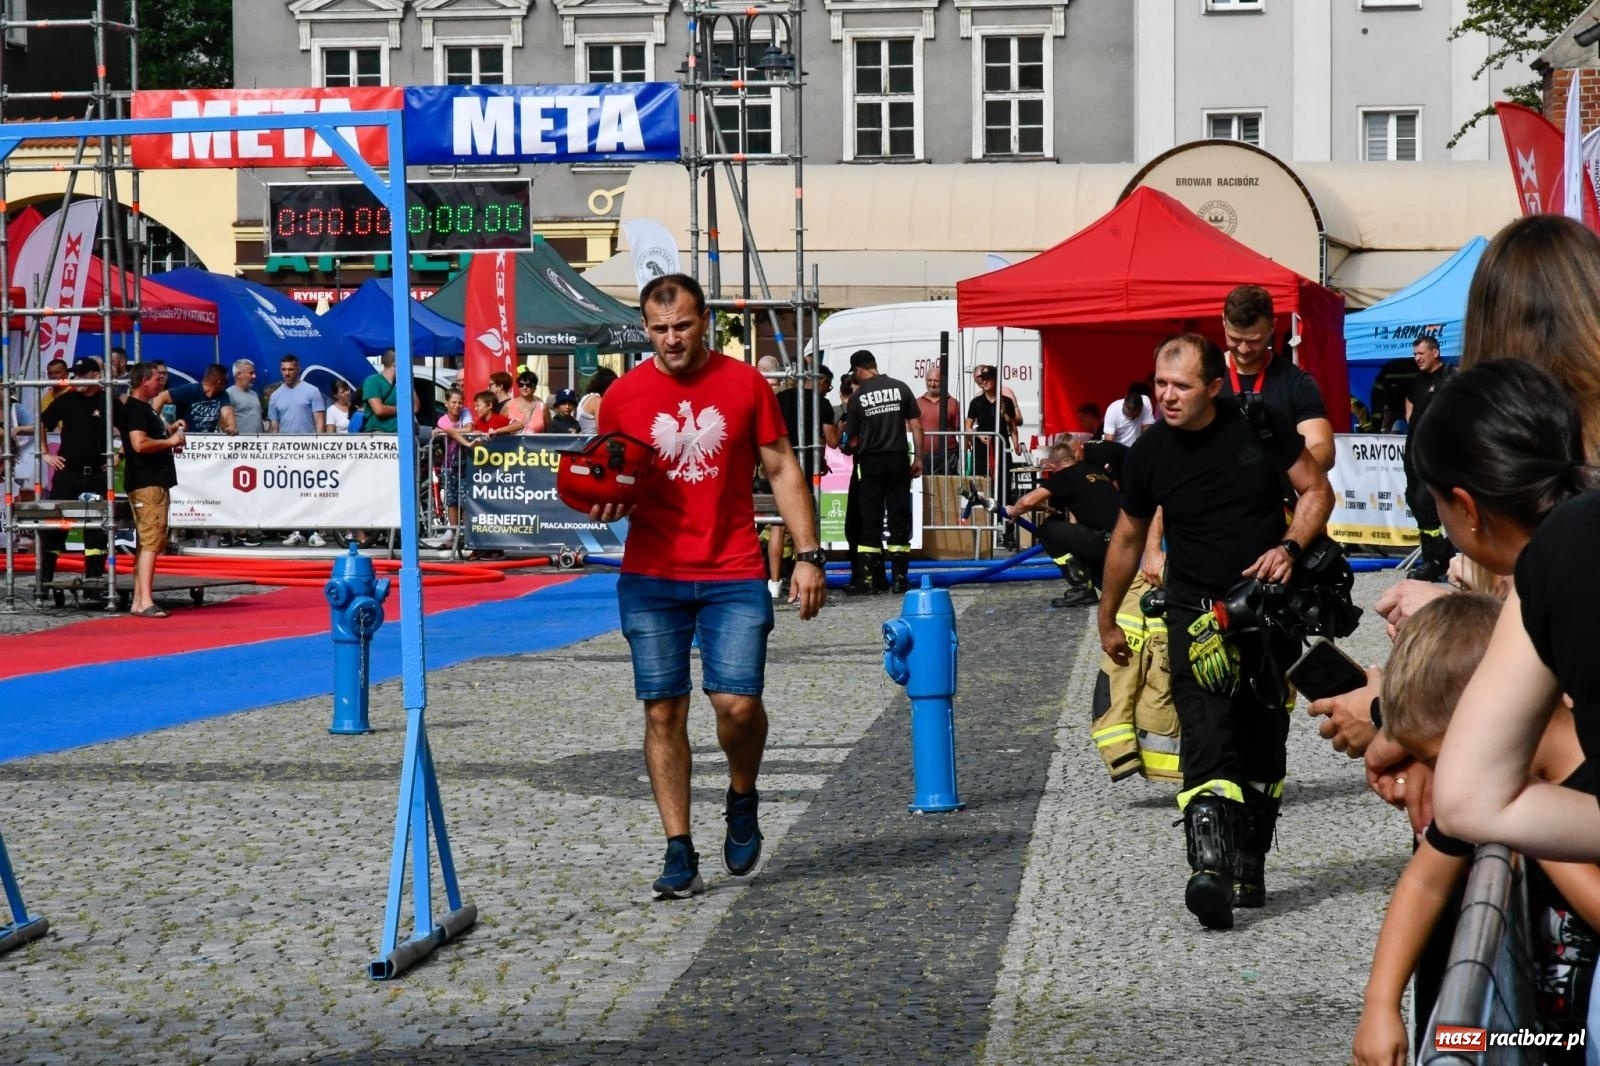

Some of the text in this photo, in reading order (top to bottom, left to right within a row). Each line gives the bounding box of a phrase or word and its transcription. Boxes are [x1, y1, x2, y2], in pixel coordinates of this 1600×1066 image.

[171, 98, 361, 160] META
[453, 95, 645, 156] META
[1175, 174, 1260, 187] BROWAR RACIBÓRZ
[408, 204, 522, 233] 0:00.00
[293, 291, 334, 300] RYNEK
[516, 332, 577, 345] ciborskie
[859, 387, 902, 408] SĘDZIA
[227, 441, 268, 454] SPRZĘT
[272, 441, 343, 451] RATOWNICZY
[346, 441, 368, 451] DLA
[370, 441, 398, 451] STRA
[214, 452, 239, 460] TYLKO
[250, 452, 304, 460] NAJLEPSZYCH
[306, 452, 347, 460] SKLEPACH
[473, 446, 561, 473] Dopłaty
[239, 470, 251, 488] D
[472, 469, 526, 483] do kart
[472, 486, 558, 504] MultiSport
[471, 514, 537, 525] #BENEFITY
[471, 525, 534, 534] PRACOWNICZE
[540, 522, 608, 531] PRACA.EKOOKNA.PL
